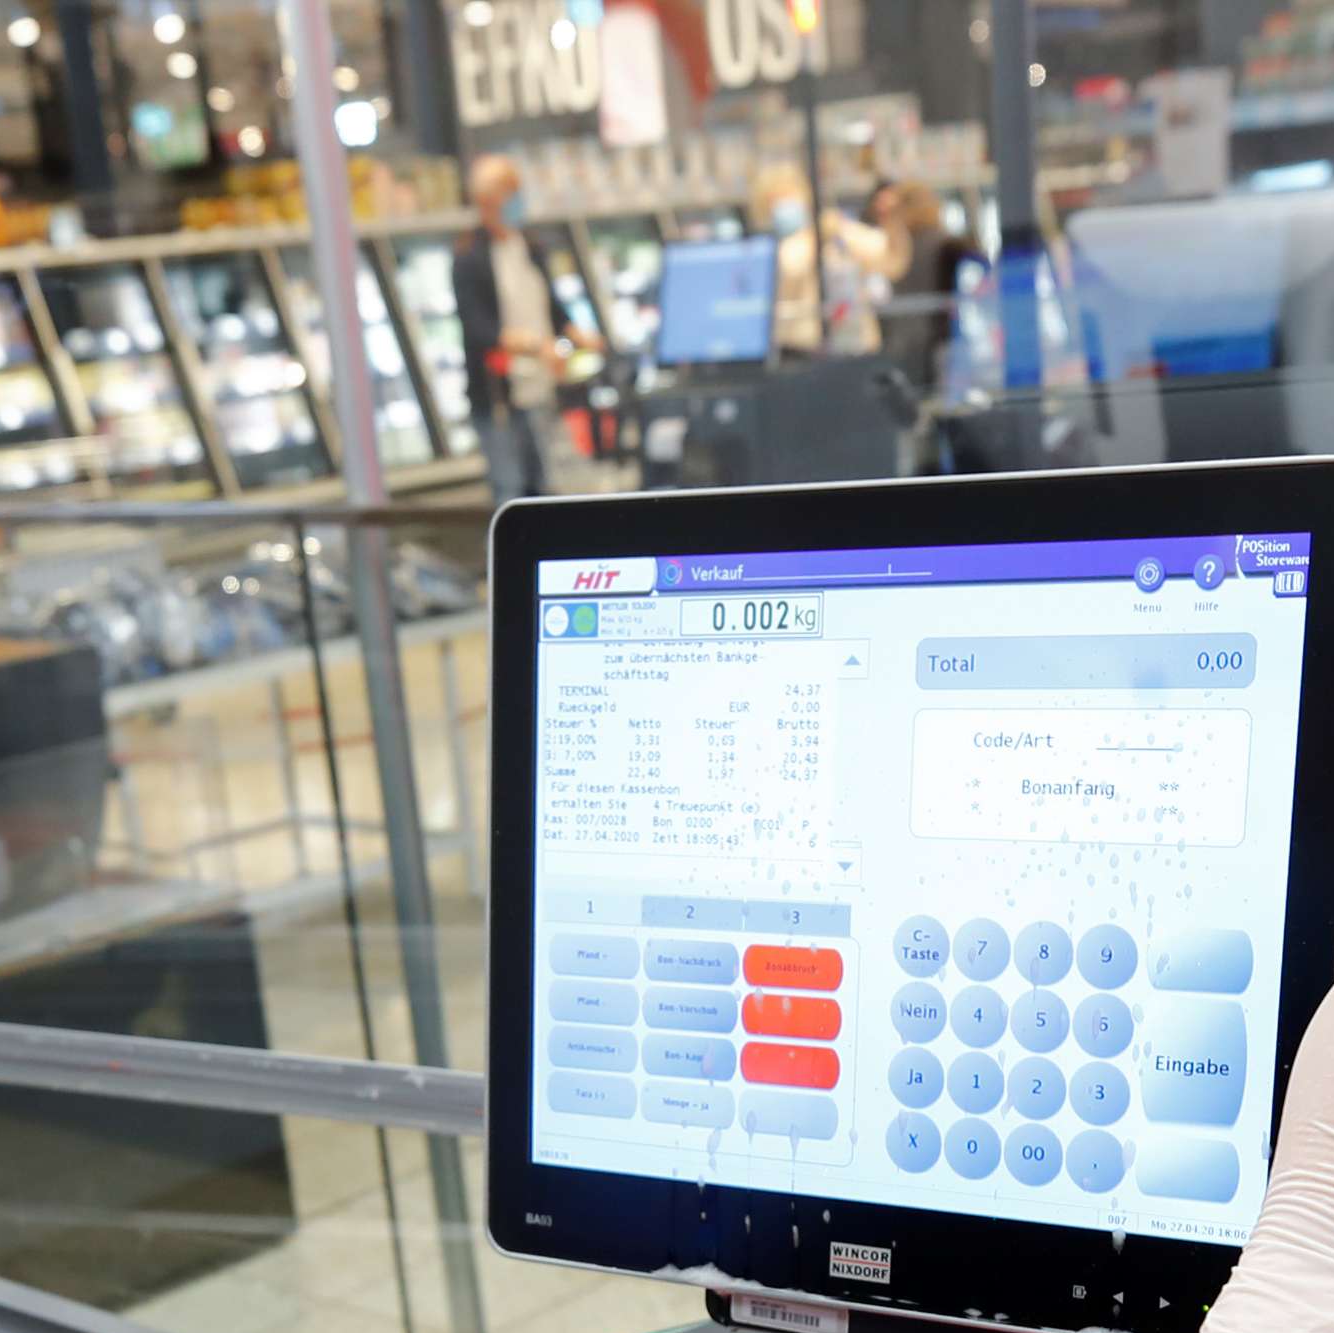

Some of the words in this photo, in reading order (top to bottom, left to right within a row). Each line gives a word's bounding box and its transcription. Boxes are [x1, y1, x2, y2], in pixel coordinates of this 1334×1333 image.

[1243, 540, 1291, 553] POSition
[573, 571, 620, 590] HIT
[691, 564, 744, 582] Verkauf
[1195, 602, 1219, 612] Hilfe
[713, 601, 789, 631] 0.002
[794, 604, 816, 631] kg
[604, 655, 624, 664] zum
[630, 652, 710, 664] übernächsten
[716, 652, 765, 665] Bankge-
[928, 654, 975, 673] Total
[1197, 651, 1243, 673] 0,00
[603, 669, 670, 682] schäftstag
[558, 686, 610, 697] TERMINAL
[785, 684, 821, 697] 24,37
[558, 702, 617, 714] Rueckgeld
[729, 702, 750, 713] EUR
[792, 702, 820, 714] 0,00
[546, 719, 585, 729] Steuer
[628, 719, 662, 729] Netto
[695, 719, 736, 730] Steuer
[777, 719, 820, 730] Brutto
[635, 735, 661, 747] 3,31
[791, 736, 820, 747] 3,94
[973, 732, 1055, 750] Code/Art
[628, 752, 661, 763] 19,09
[708, 752, 735, 763] 1,34
[783, 753, 819, 764] 20,43
[544, 767, 576, 777] Summe
[627, 768, 661, 779] 22,40
[707, 769, 735, 780] 1,97
[782, 770, 818, 781] 24,37
[551, 782, 571, 793] Für
[576, 782, 615, 794] diesen
[620, 784, 680, 795] Kassenbon
[1021, 779, 1115, 799] Bonanfang
[551, 798, 602, 810] erhalten
[608, 800, 628, 810] Sie
[667, 800, 733, 813] Treuepunkt
[653, 817, 673, 827] Bon
[575, 830, 640, 842] 27.04.2020
[652, 832, 678, 844] Zeit
[587, 901, 594, 914] 1
[685, 905, 695, 919] 2
[792, 910, 801, 924] 3
[913, 930, 931, 943] C-
[901, 947, 940, 962] Taste
[978, 941, 988, 956] 7
[1039, 944, 1050, 960] 8
[1100, 946, 1113, 963] 9
[900, 1003, 938, 1020] Nein
[973, 1008, 983, 1023] 4
[1036, 1013, 1047, 1028] 5
[1098, 1017, 1109, 1032] 6
[1155, 1055, 1230, 1077] Eingabe
[907, 1069, 923, 1086] Ja
[972, 1074, 980, 1089] 1
[1032, 1079, 1042, 1094] 2
[1094, 1085, 1105, 1100] 3
[967, 1139, 978, 1154] 0
[1022, 1145, 1045, 1161] 00
[1107, 1214, 1127, 1226] 007
[1151, 1220, 1167, 1230] Mo
[1170, 1223, 1214, 1236] 27.04.20
[1218, 1228, 1248, 1240] 18:06
[832, 1245, 890, 1263] WINCOR
[832, 1263, 889, 1279] NIXDORF
